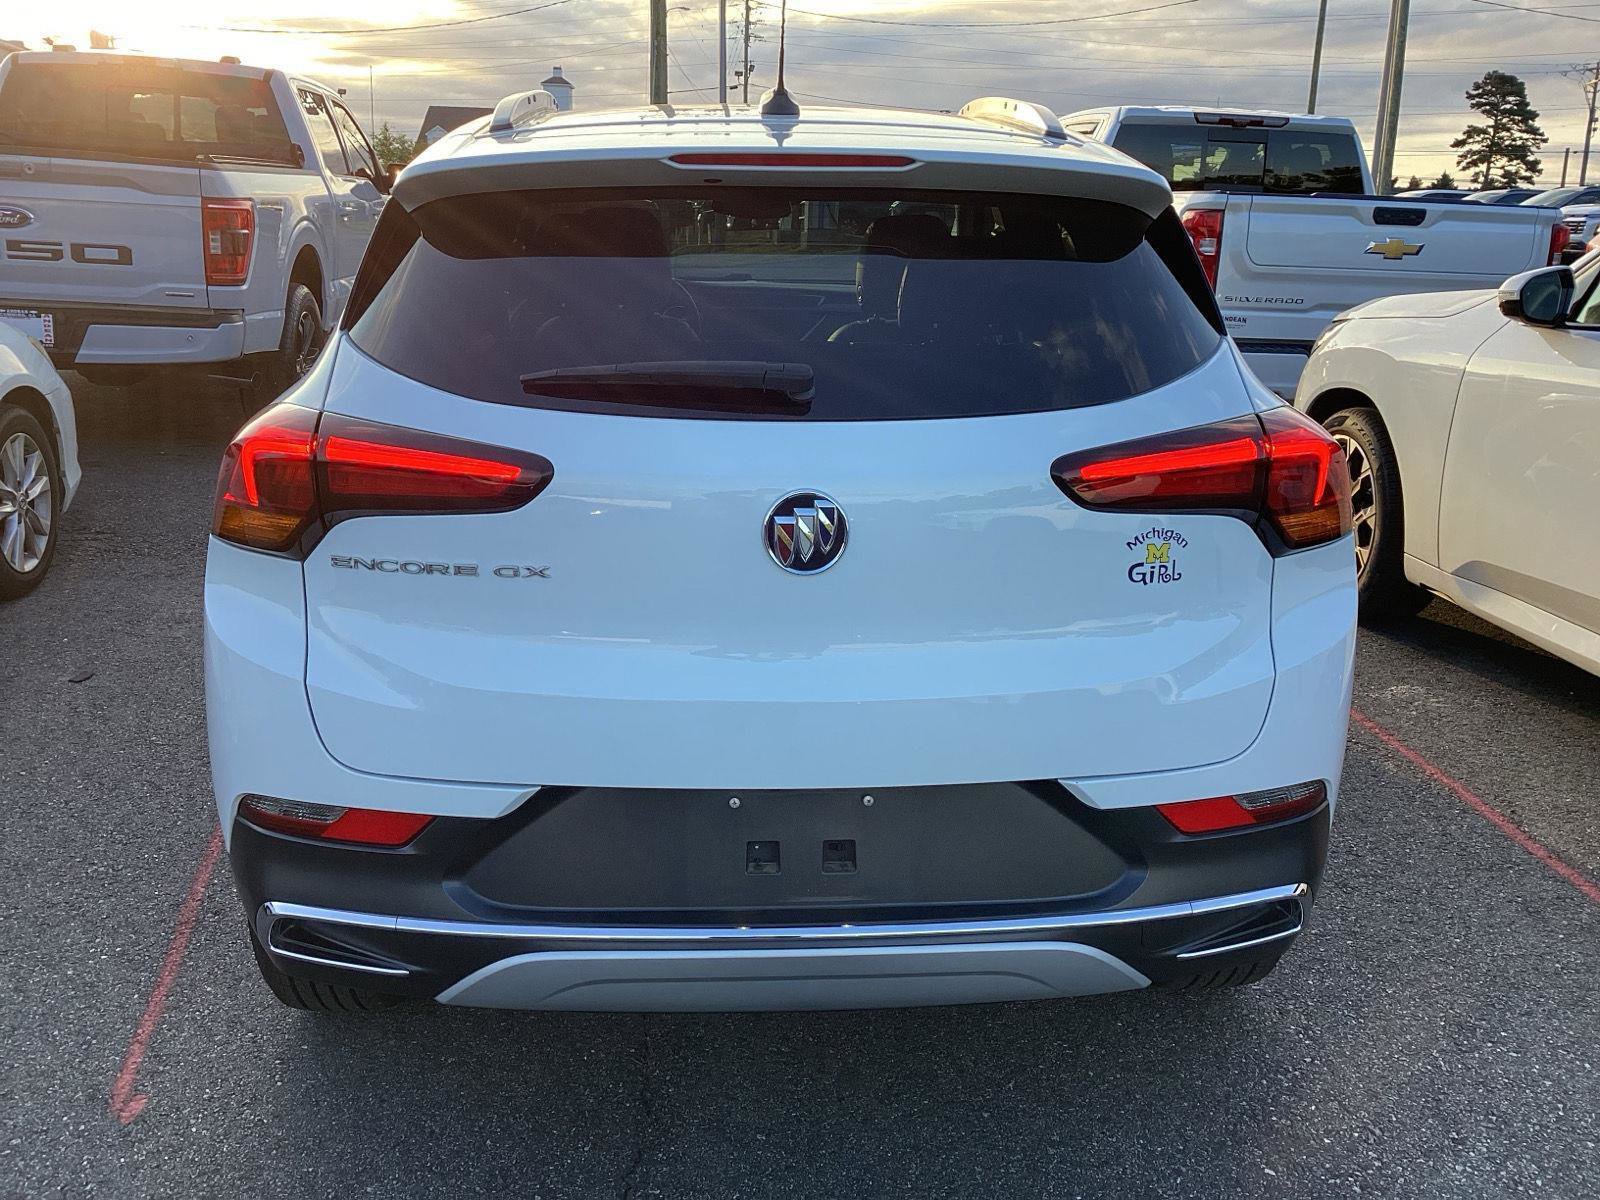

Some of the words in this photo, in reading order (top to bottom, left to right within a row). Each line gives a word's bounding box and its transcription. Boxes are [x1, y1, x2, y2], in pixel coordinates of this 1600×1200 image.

[1224, 295, 1304, 305] SILVERADO
[1224, 315, 1248, 324] NDEAN
[1126, 527, 1188, 551] Michigan
[1146, 542, 1171, 565] M
[330, 554, 480, 578] ENCORE
[493, 564, 551, 578] GX
